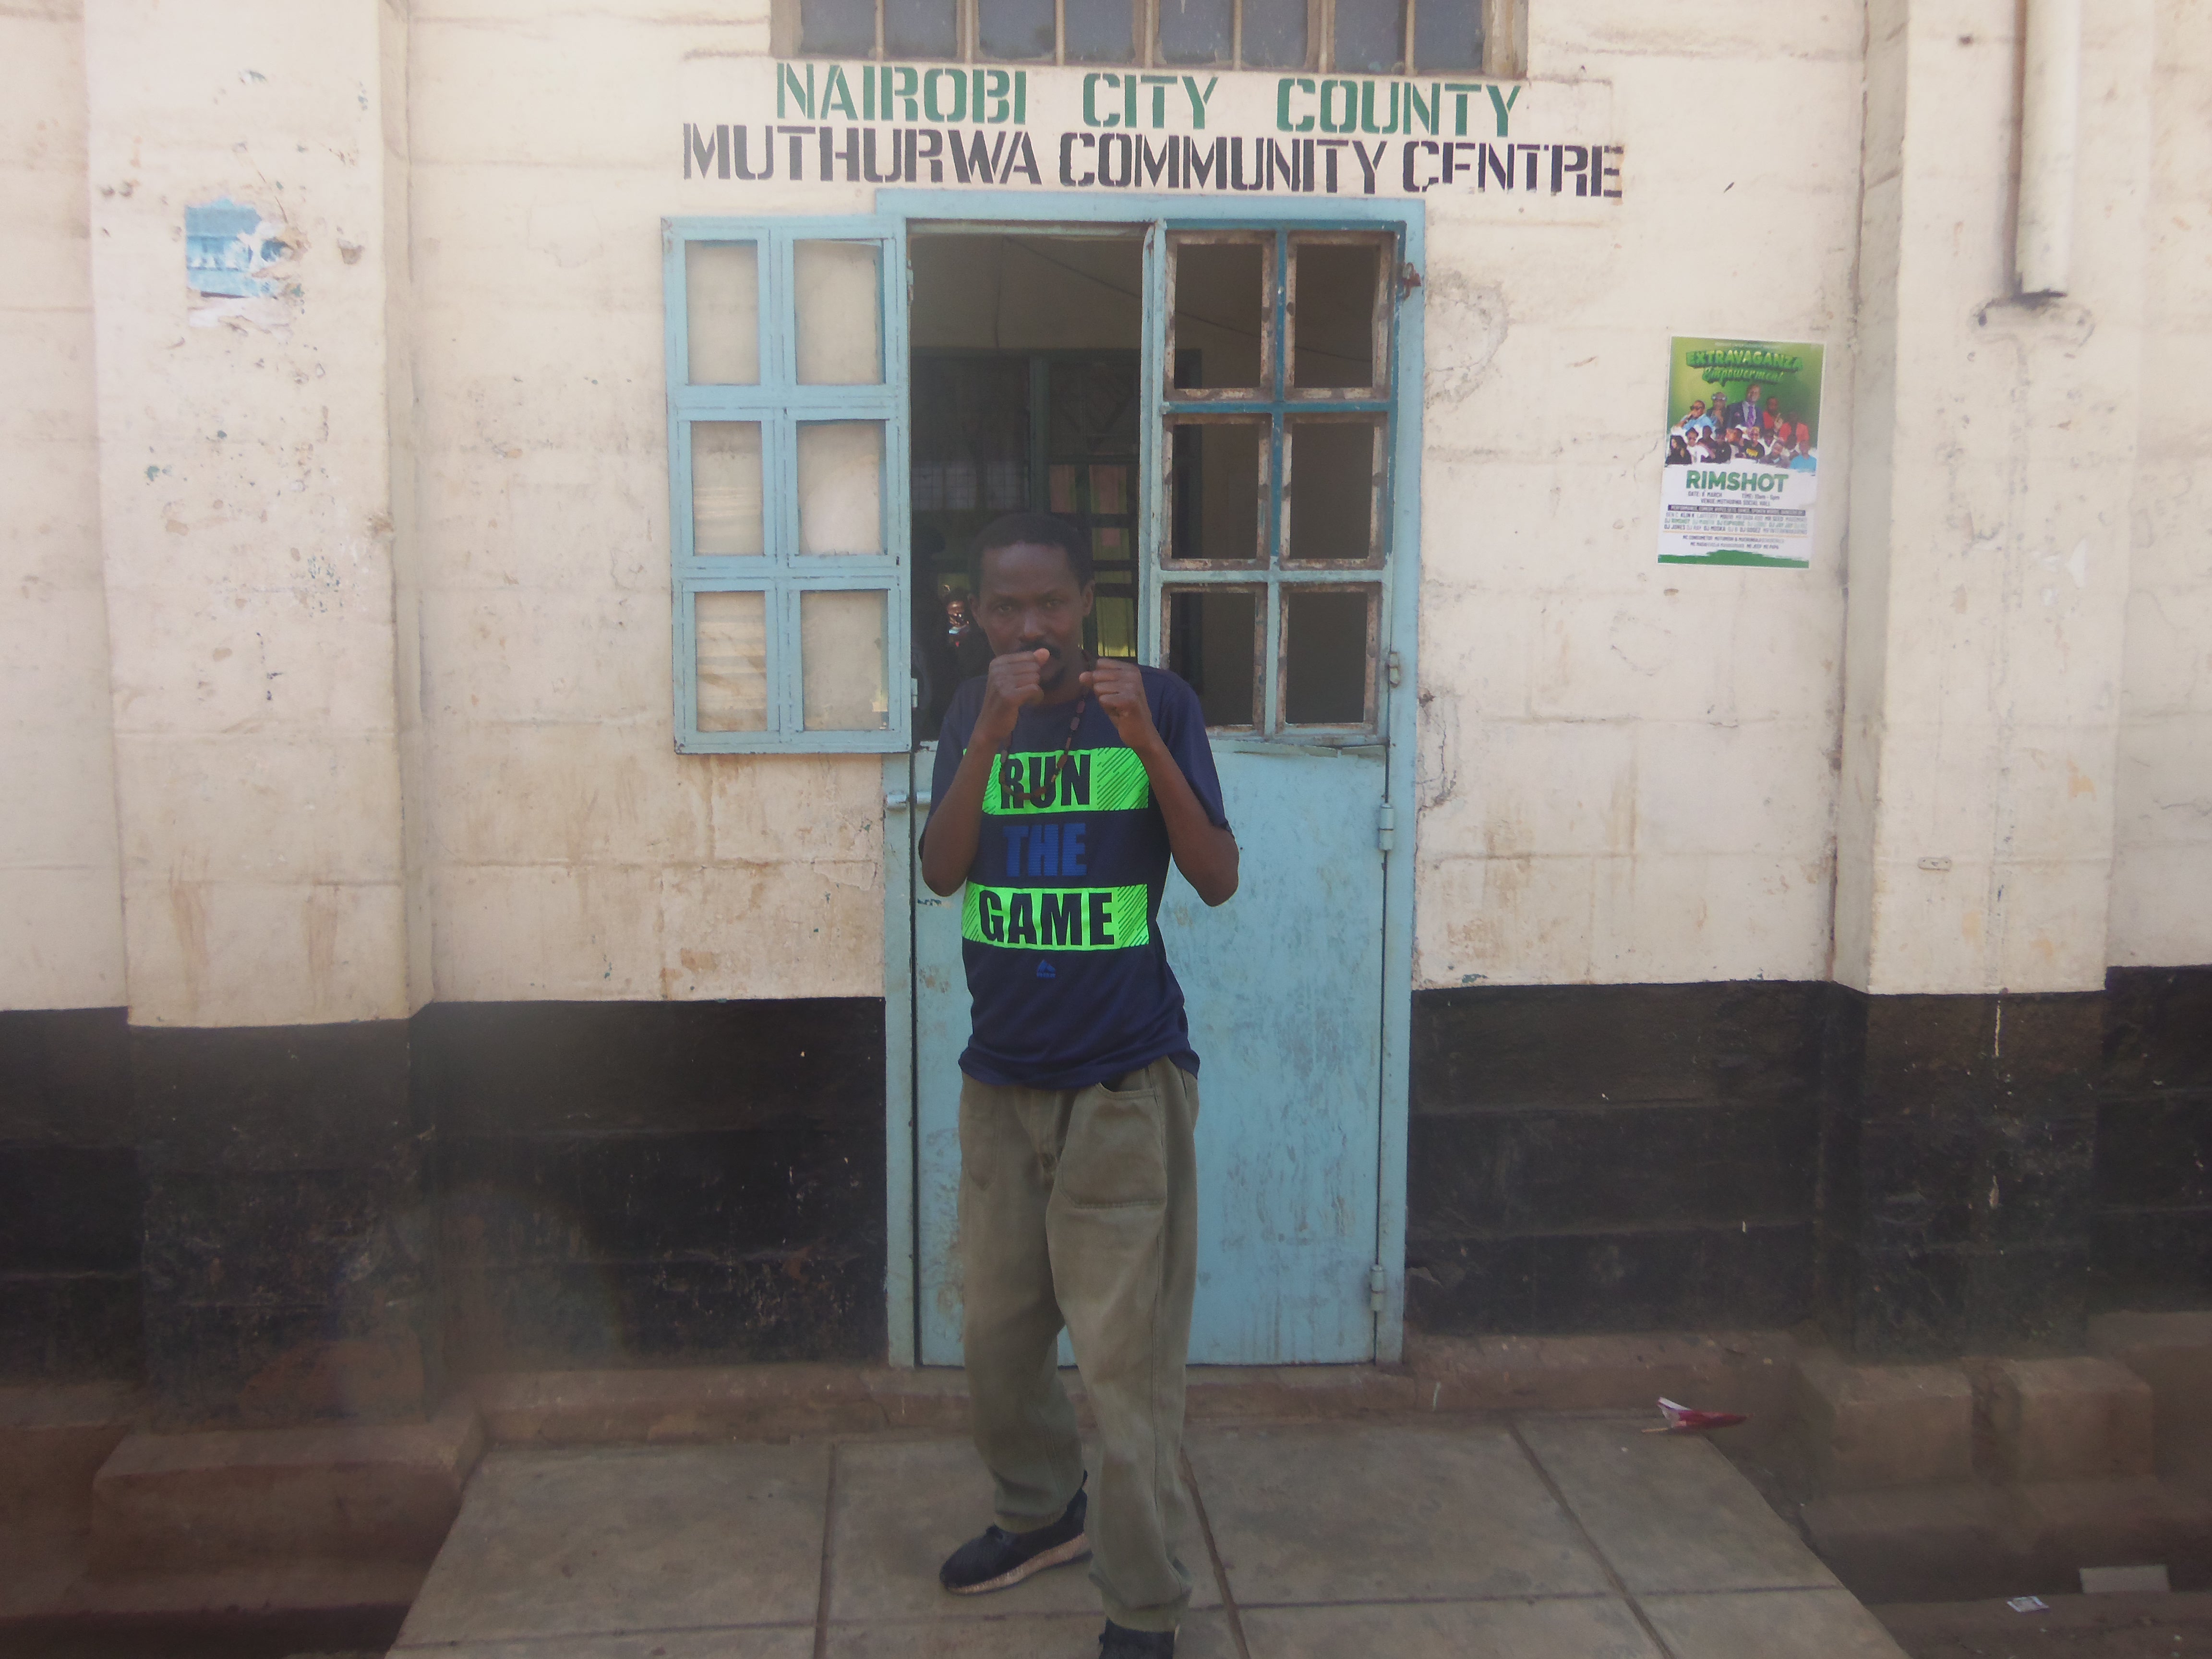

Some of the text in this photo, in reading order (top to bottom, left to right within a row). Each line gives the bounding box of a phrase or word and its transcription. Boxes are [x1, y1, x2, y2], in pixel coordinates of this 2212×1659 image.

[777, 62, 1521, 138] NAIROBI CITY COUNTY
[683, 122, 1624, 197] MUTHURWA COMMUNITY CENTRE
[1685, 349, 1803, 373] EXTRAVAGANZA
[1685, 470, 1789, 493] RIMSHOT
[998, 754, 1091, 809] RUN
[1003, 823, 1087, 877] THE
[978, 890, 1115, 946] GAME
